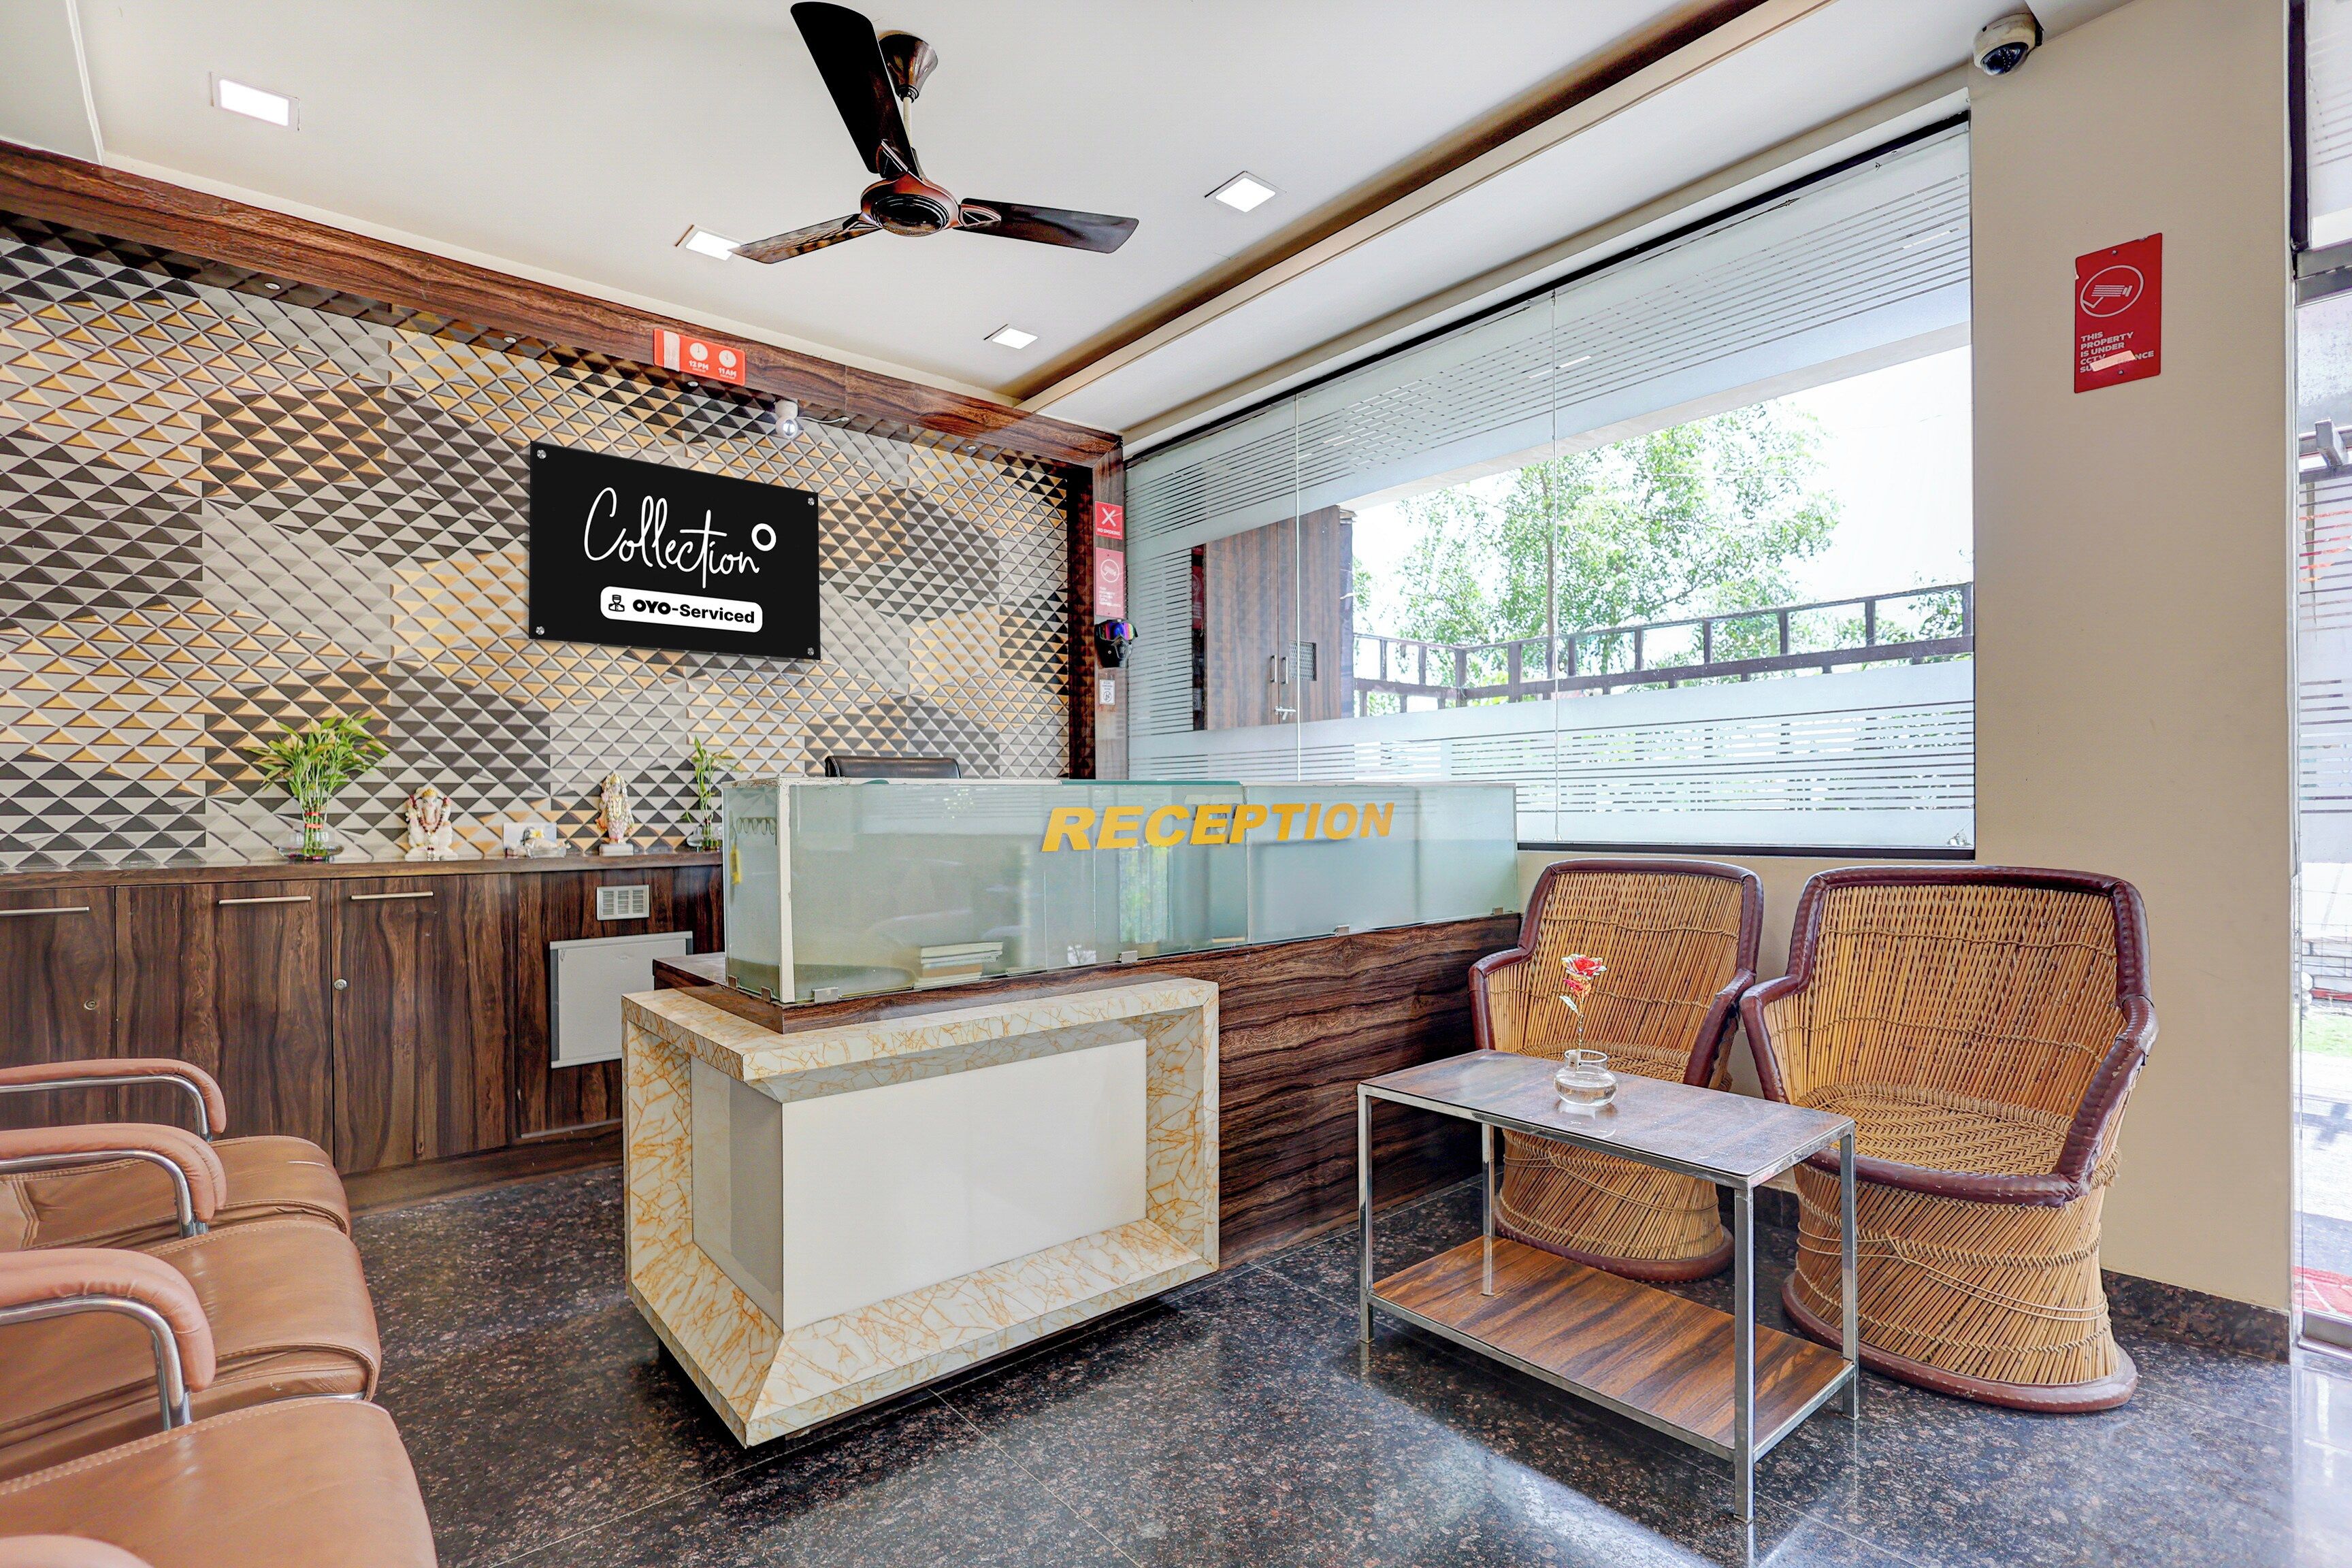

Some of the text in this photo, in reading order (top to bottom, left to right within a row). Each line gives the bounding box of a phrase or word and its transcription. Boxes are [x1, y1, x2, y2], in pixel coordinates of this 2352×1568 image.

[2080, 331, 2104, 342] THIS
[2080, 331, 2134, 350] PROPERTY
[2091, 342, 2125, 355] UNDER
[584, 487, 760, 589] Collection
[632, 599, 755, 624] OYO-Serviced
[1041, 802, 1394, 852] RECEPTION
